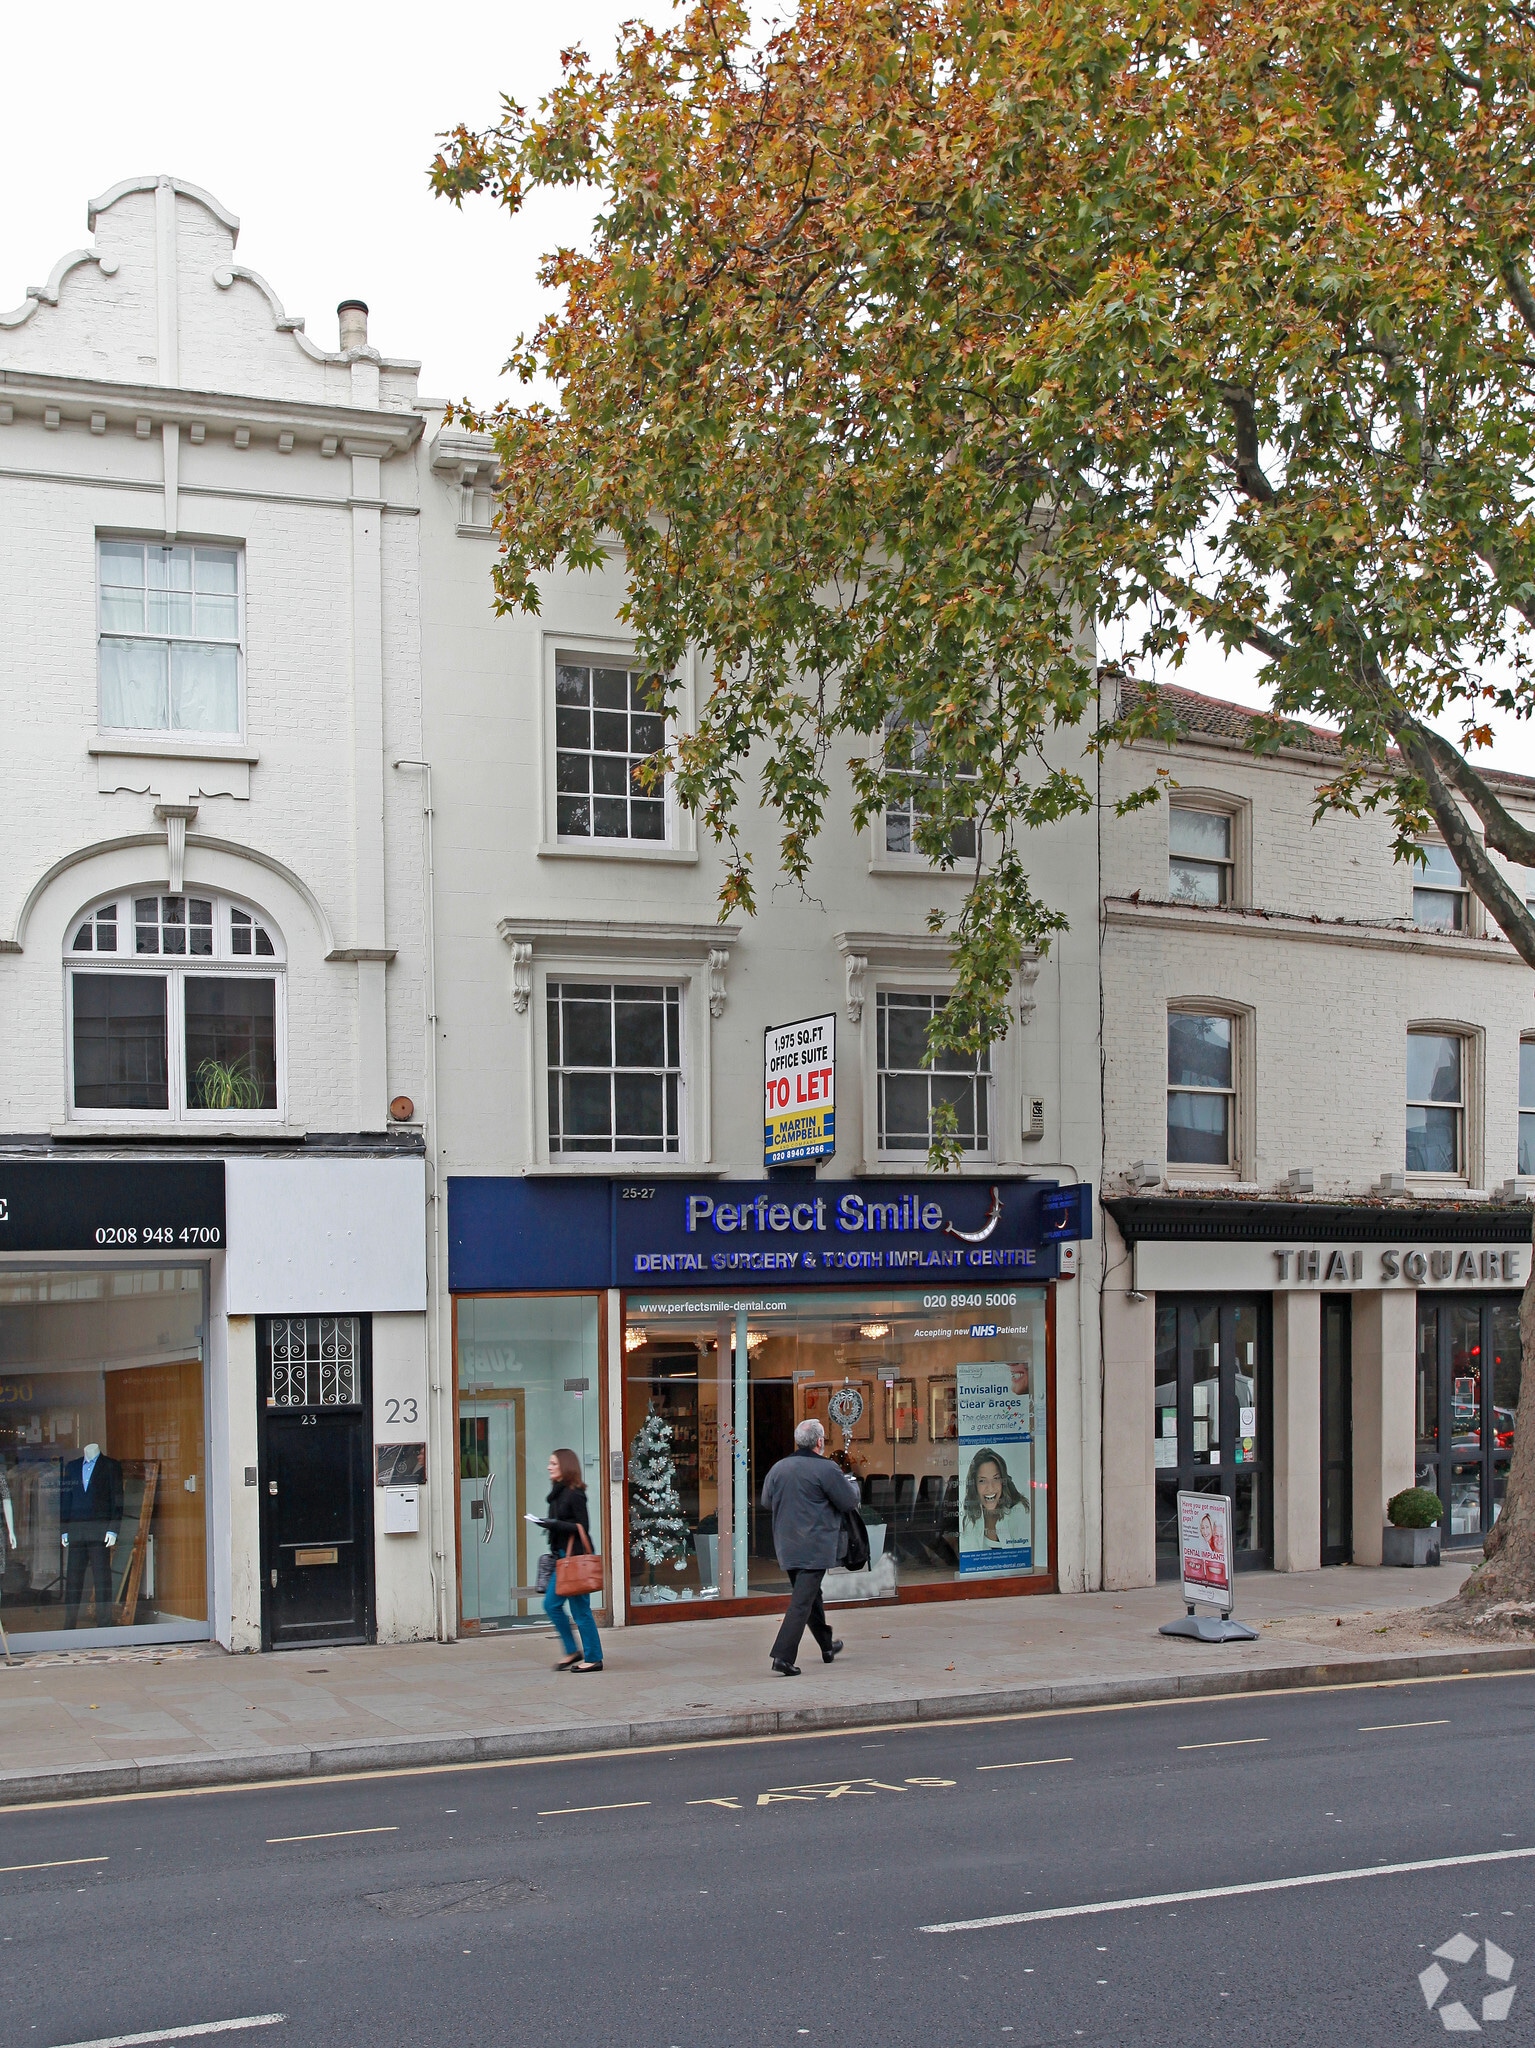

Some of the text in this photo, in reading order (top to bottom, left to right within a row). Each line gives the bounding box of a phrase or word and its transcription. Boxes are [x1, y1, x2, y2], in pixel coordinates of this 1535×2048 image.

[774, 1026, 824, 1053] 1,975 SQ.FT
[770, 1046, 828, 1072] OFFICE SUITE
[766, 1068, 833, 1110] TO LET
[779, 1116, 817, 1134] MARTIN
[774, 1126, 823, 1145] CAMPBELL
[772, 1150, 785, 1161] 020
[786, 1148, 804, 1160] 8940
[622, 1188, 656, 1199] 25-27
[688, 1194, 943, 1232] Perfect Smile
[95, 1227, 220, 1244] 0208 948 4700
[636, 1249, 1037, 1271] DENTAL SURGERY & TOOTH IMPLANT CENTRE
[1273, 1249, 1520, 1285] THAI SQUARE
[639, 1300, 787, 1315] www.perfectsmile-dental.com
[923, 1293, 1017, 1308] 020 8940 5006
[914, 1325, 1029, 1338] Accepting new NHS Patients!
[959, 1384, 1009, 1396] Invisalign
[384, 1397, 419, 1424] 23
[959, 1399, 1022, 1409] Clear Braces
[301, 1414, 317, 1425] 23
[1183, 1547, 1225, 1562] DENTAL IMPLANTS
[684, 1777, 958, 1809] TAXIS
